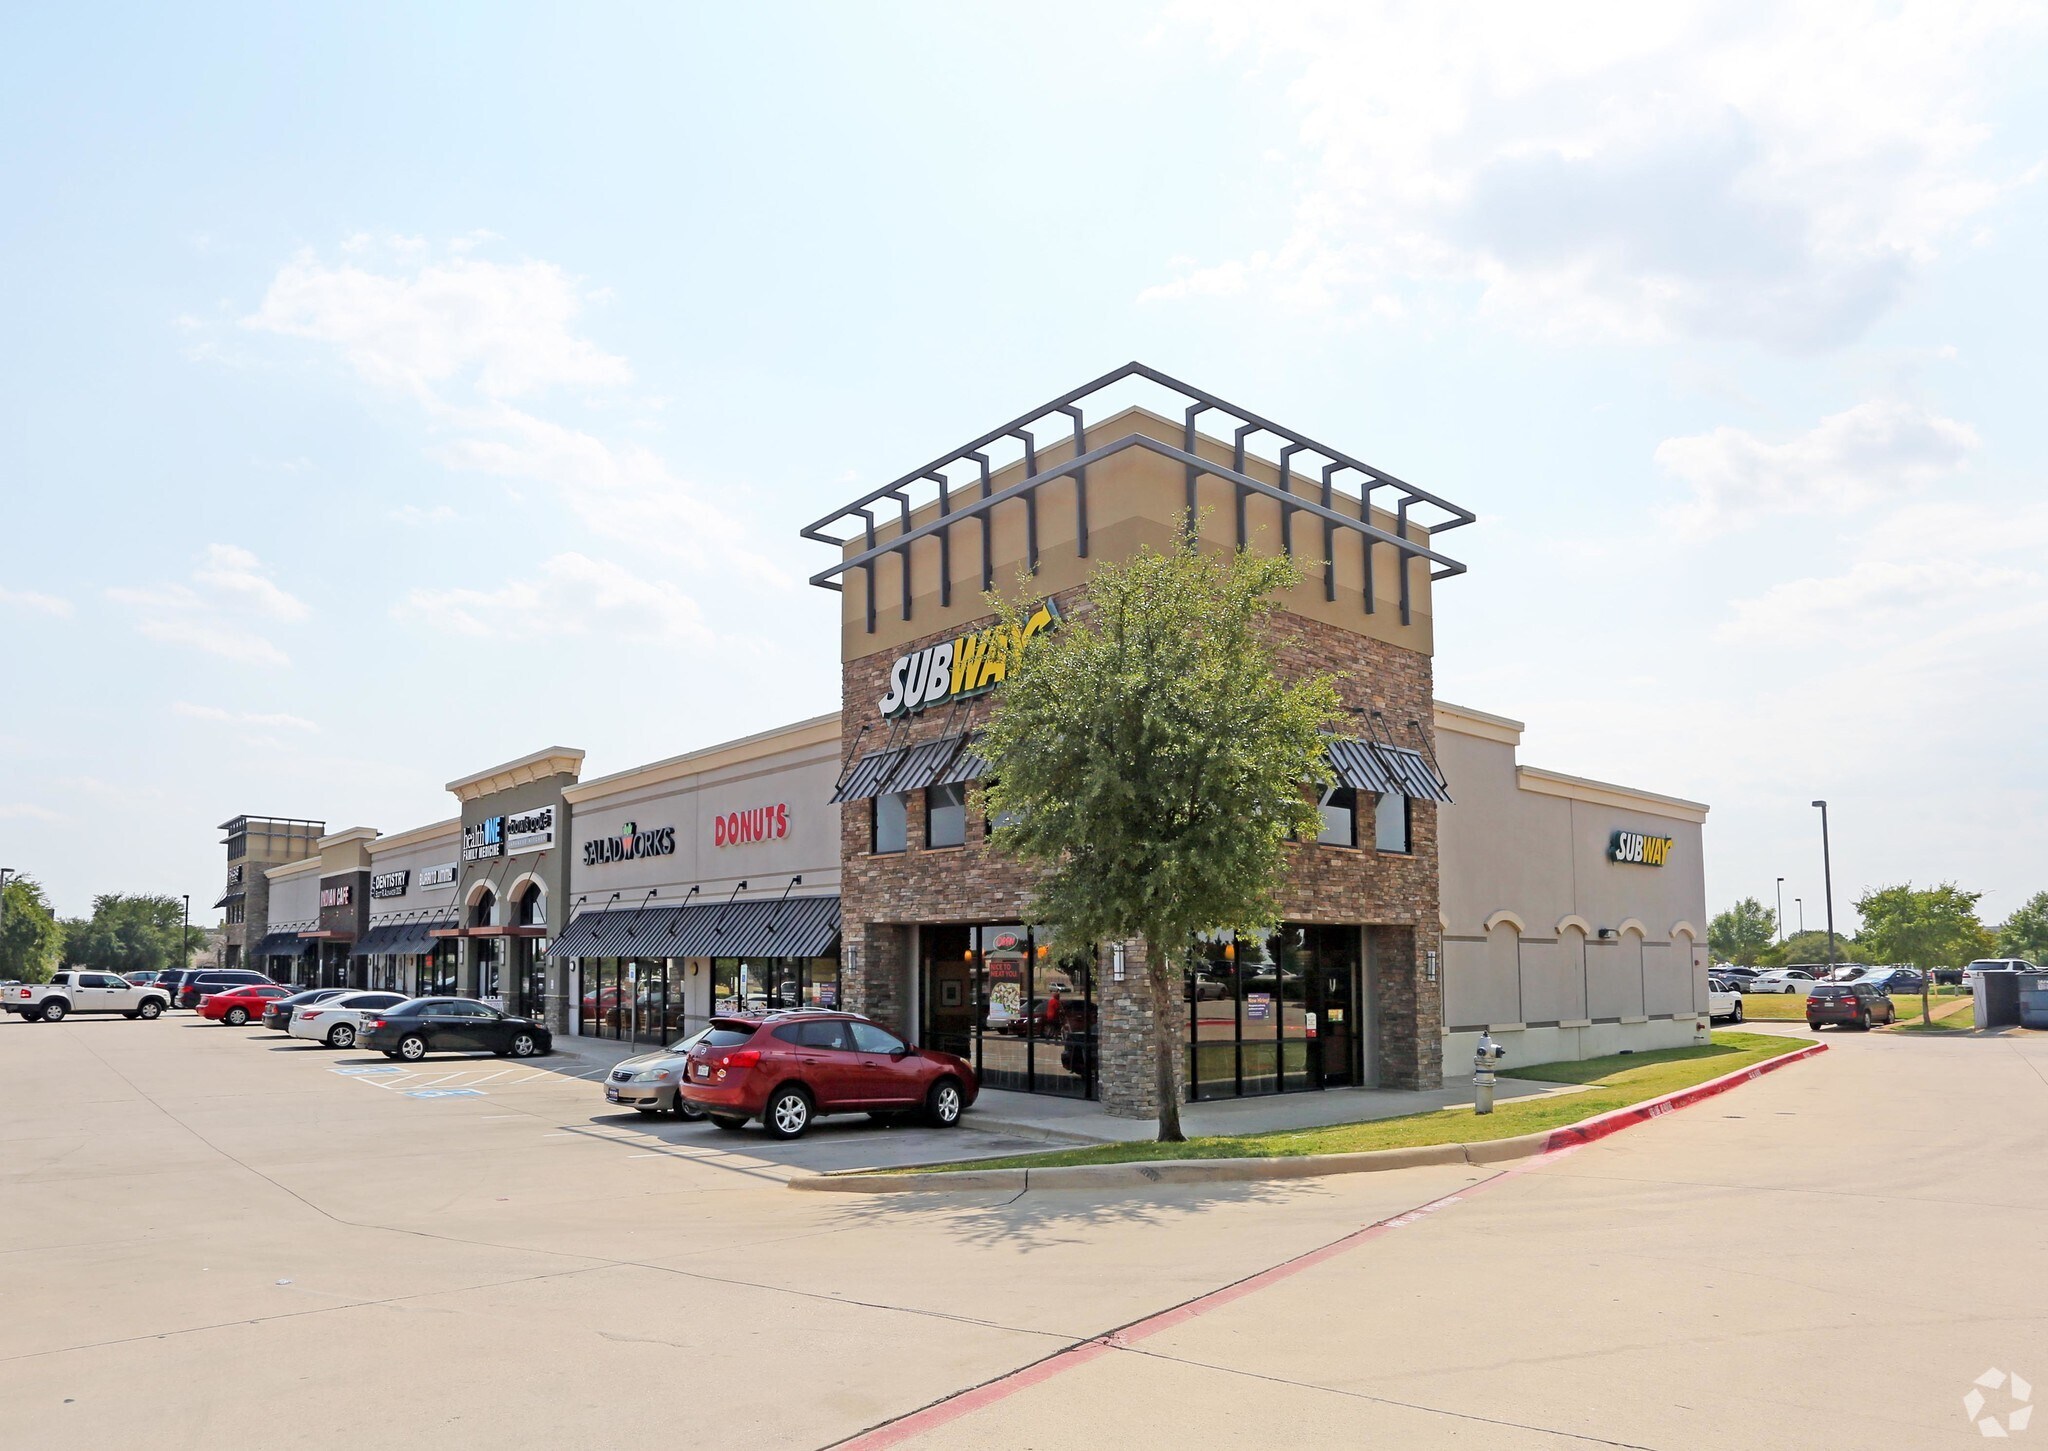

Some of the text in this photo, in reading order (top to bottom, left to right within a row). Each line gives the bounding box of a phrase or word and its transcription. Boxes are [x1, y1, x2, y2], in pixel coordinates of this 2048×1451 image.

[878, 604, 1051, 717] SUBWAY
[715, 803, 787, 846] DONUTS
[478, 843, 500, 859] MEDICINE
[582, 823, 674, 866] SALADWORKS
[1615, 832, 1673, 865] SUBWAY
[375, 871, 406, 890] DENTISTRY
